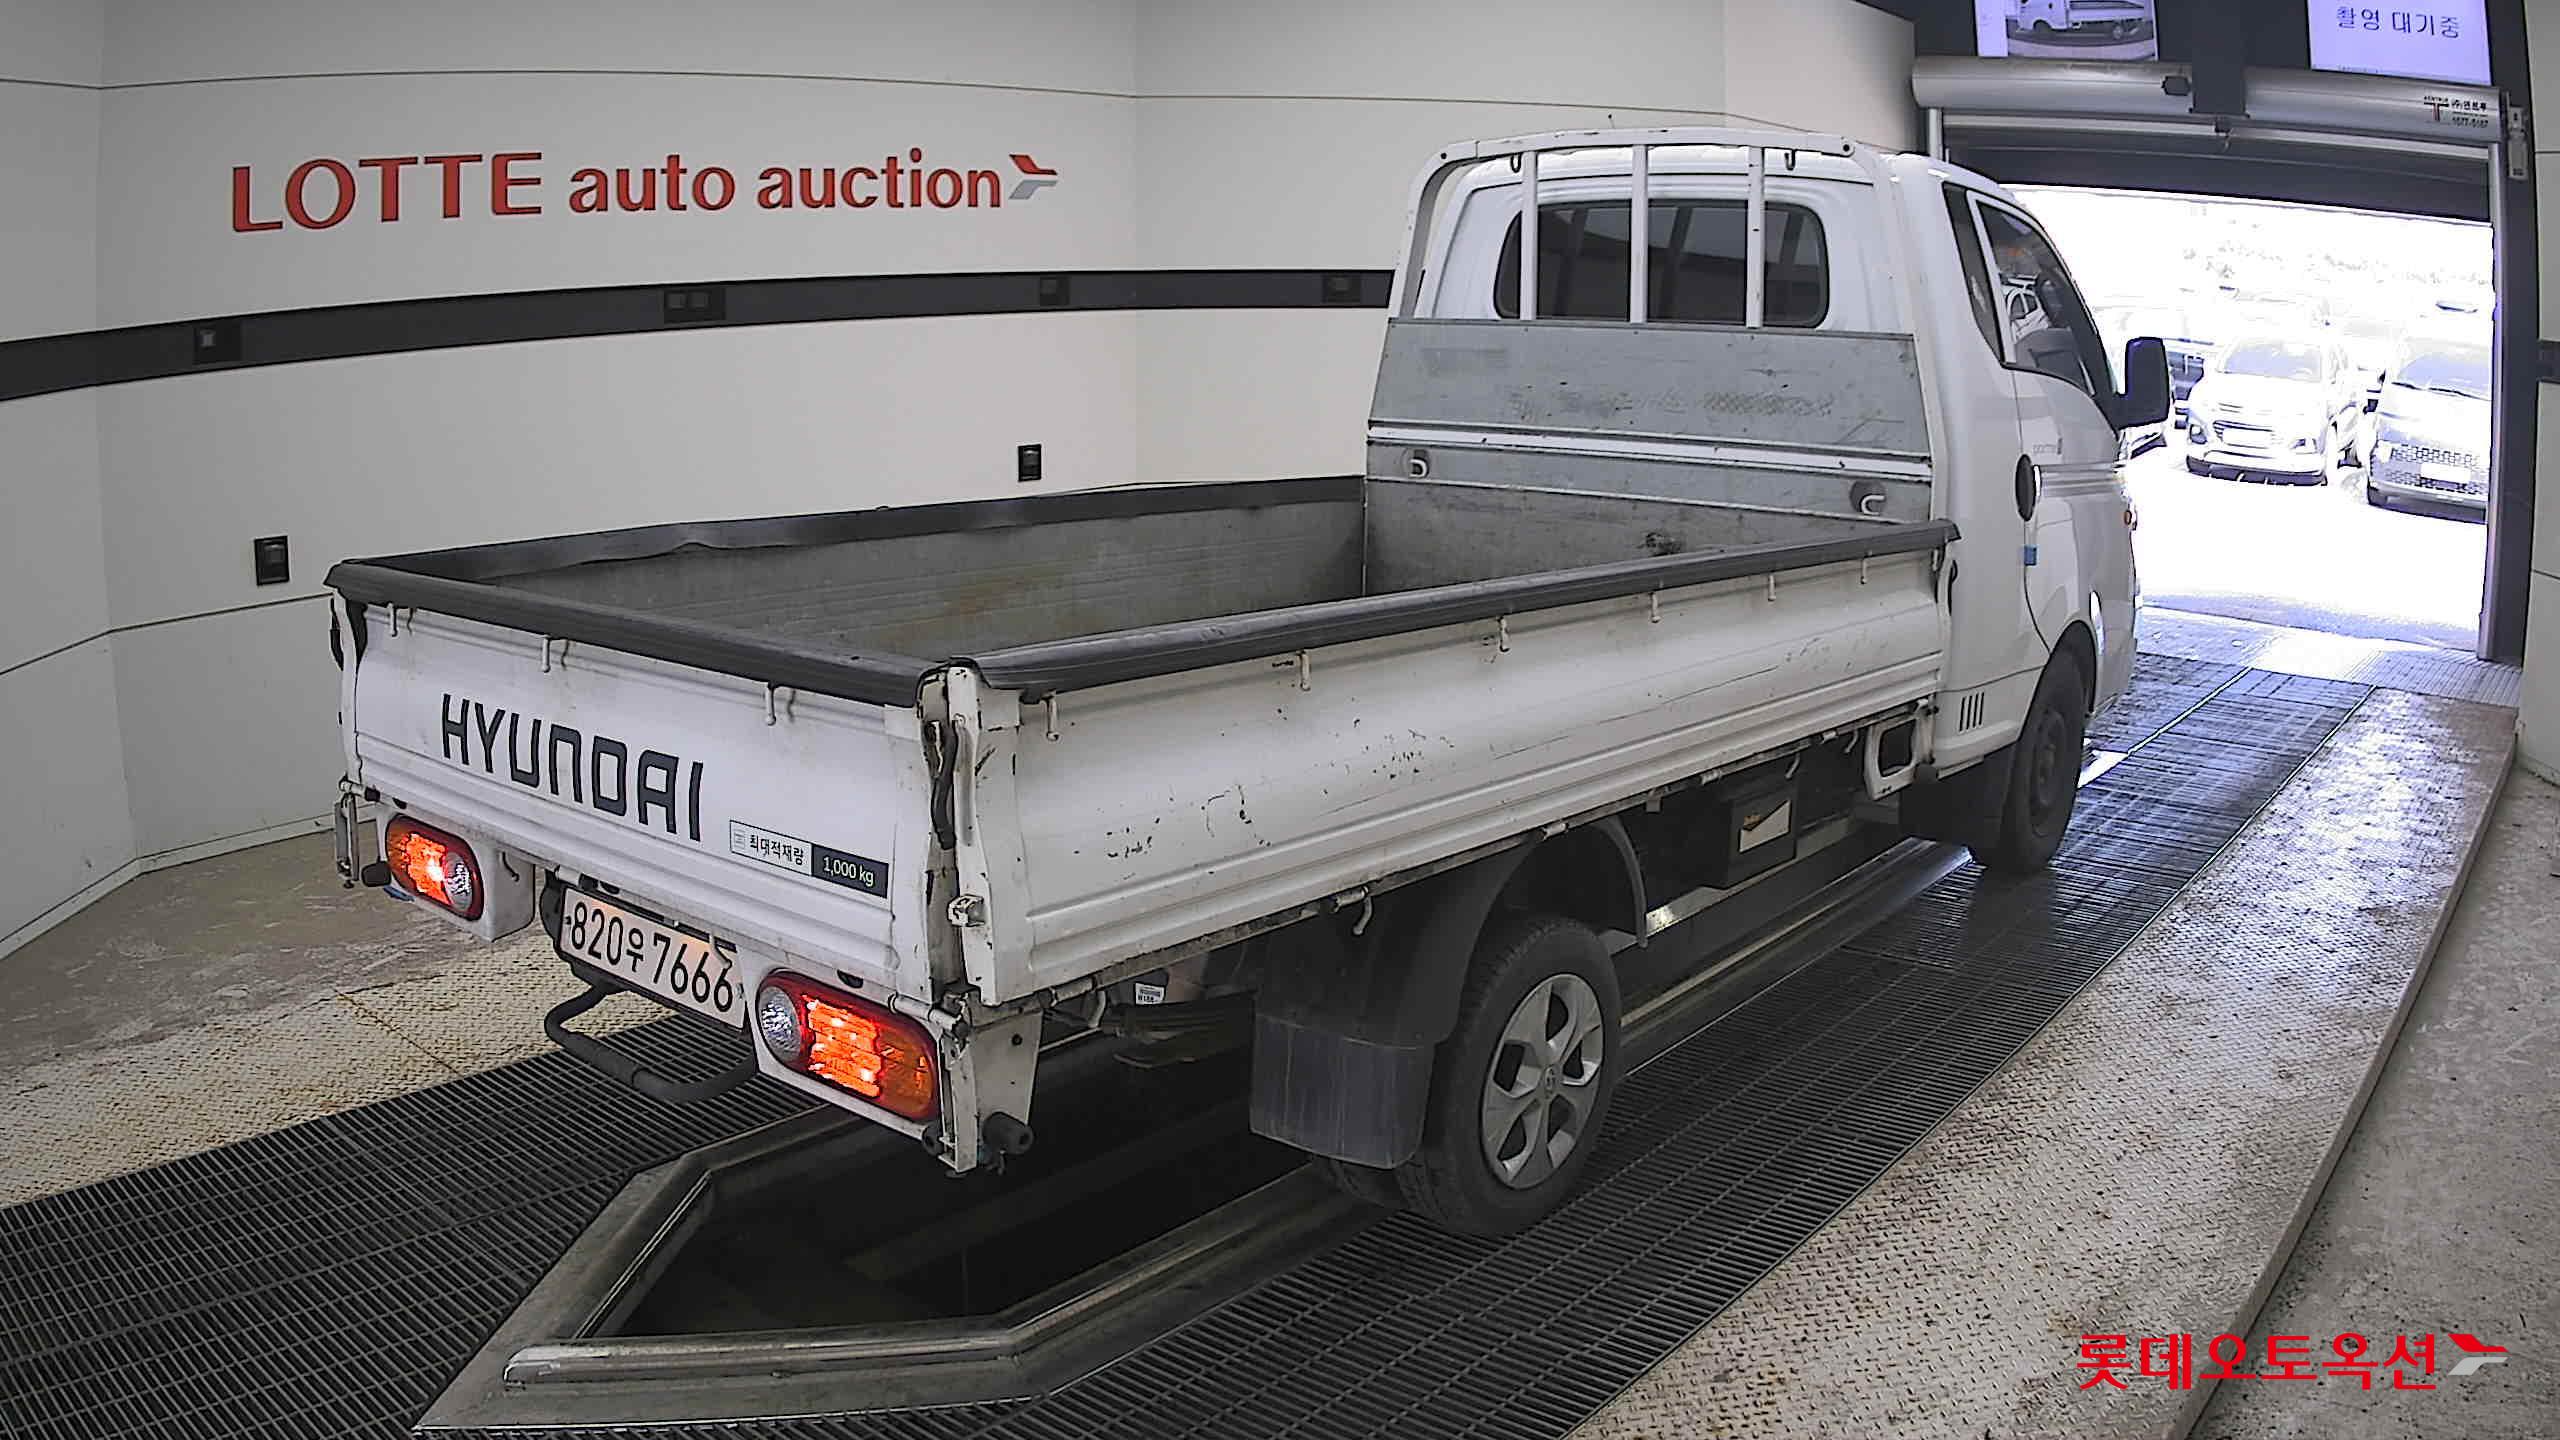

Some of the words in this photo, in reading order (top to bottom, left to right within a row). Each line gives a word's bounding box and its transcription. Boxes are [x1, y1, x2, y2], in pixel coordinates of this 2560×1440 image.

[2336, 6, 2381, 32] 촬영
[2391, 12, 2459, 39] 대기중
[232, 152, 542, 233] LOTTE
[568, 154, 736, 213] auto
[757, 148, 1001, 209] auction
[441, 693, 704, 842] HYUNDAI
[822, 856, 857, 880] 1,000
[859, 864, 874, 887] kg
